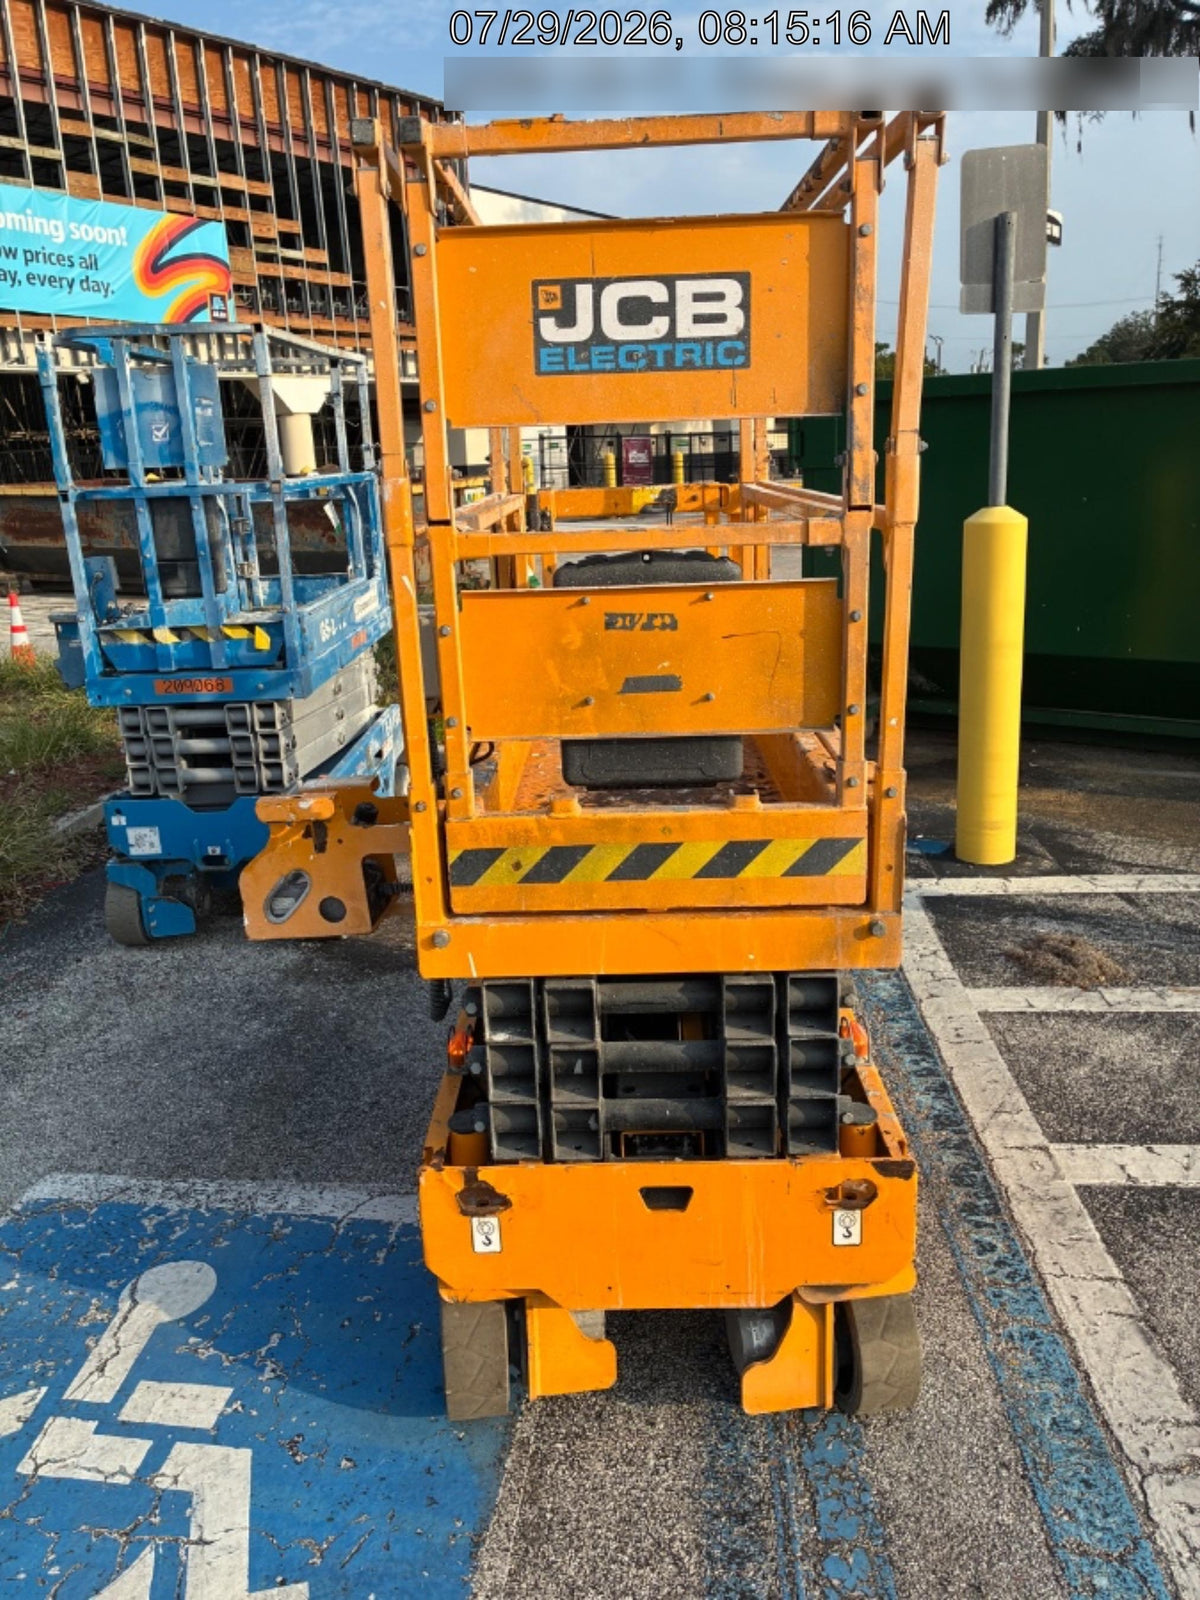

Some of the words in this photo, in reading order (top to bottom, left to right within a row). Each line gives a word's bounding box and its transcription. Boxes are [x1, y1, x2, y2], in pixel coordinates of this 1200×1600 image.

[69, 221, 128, 247] soon!
[0, 245, 18, 260] w
[22, 246, 75, 268] prices
[79, 253, 98, 271] all
[26, 272, 75, 295] every
[79, 275, 115, 298] day.
[538, 278, 746, 343] JCB
[539, 340, 746, 372] ELECTRIC
[163, 677, 225, 694] 209068
